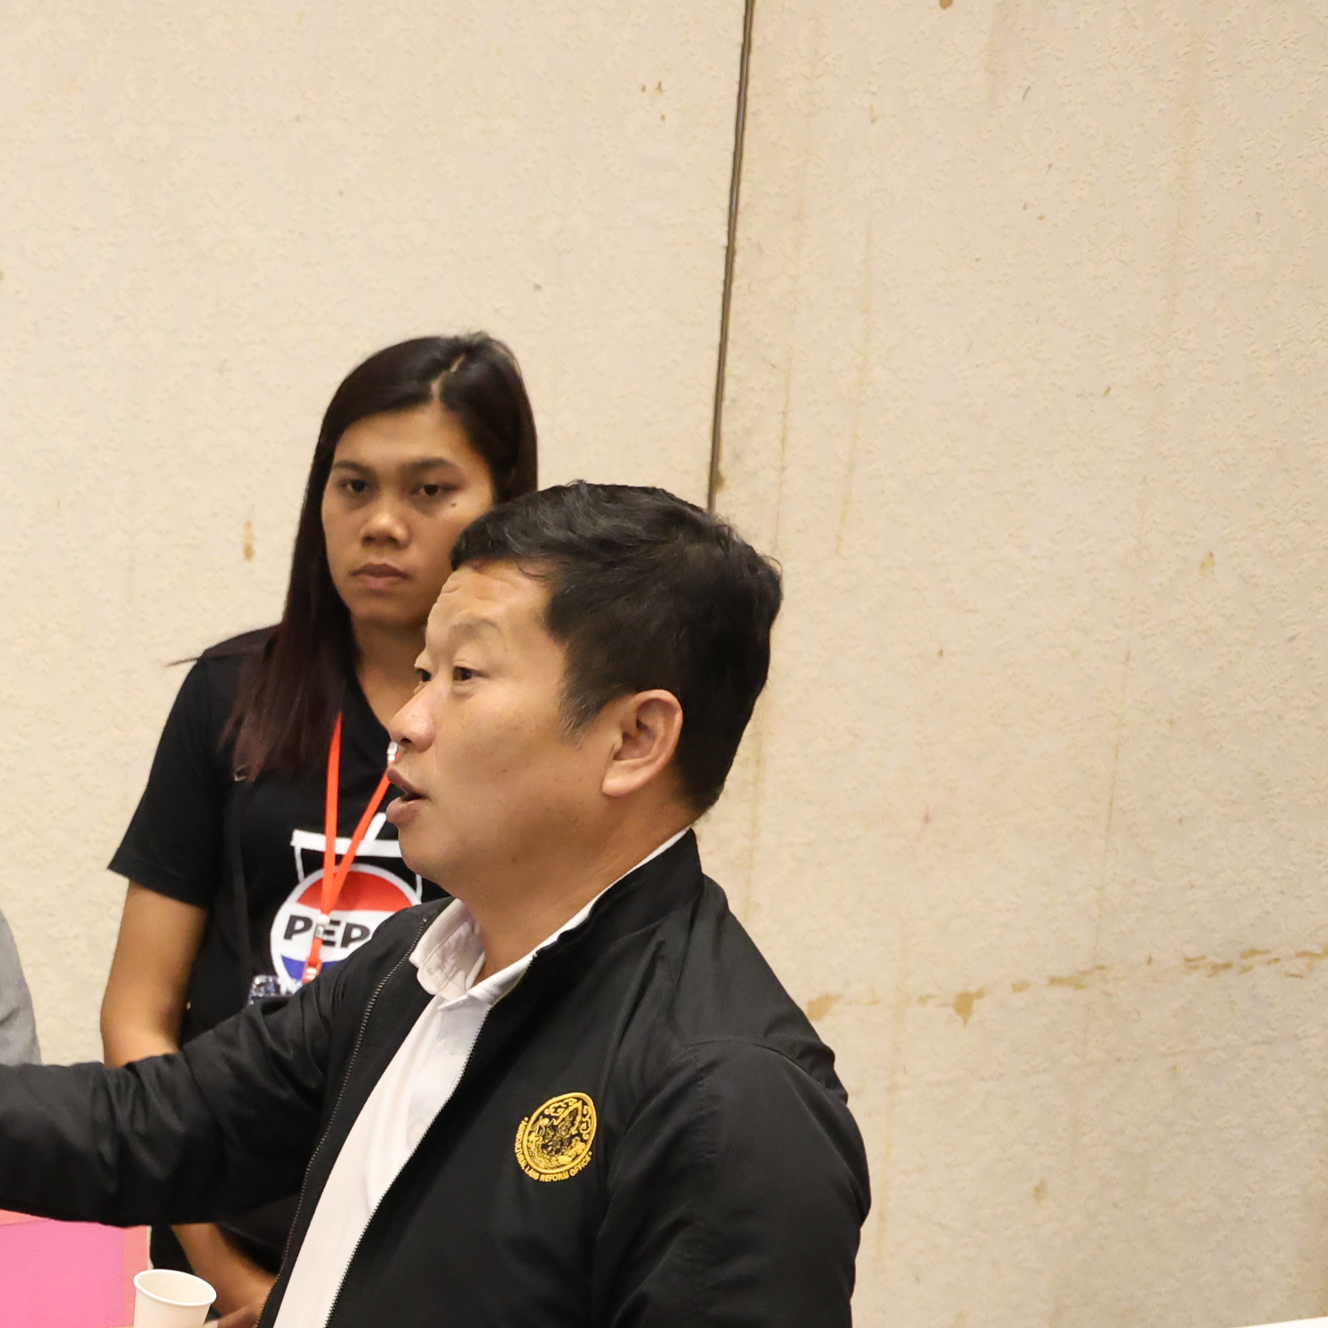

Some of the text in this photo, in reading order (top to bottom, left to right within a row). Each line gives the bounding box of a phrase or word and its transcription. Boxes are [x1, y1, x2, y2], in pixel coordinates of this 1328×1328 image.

[525, 1165, 540, 1181] LAND
[540, 1171, 570, 1182] REFORM
[569, 1154, 592, 1177] OFFICE
